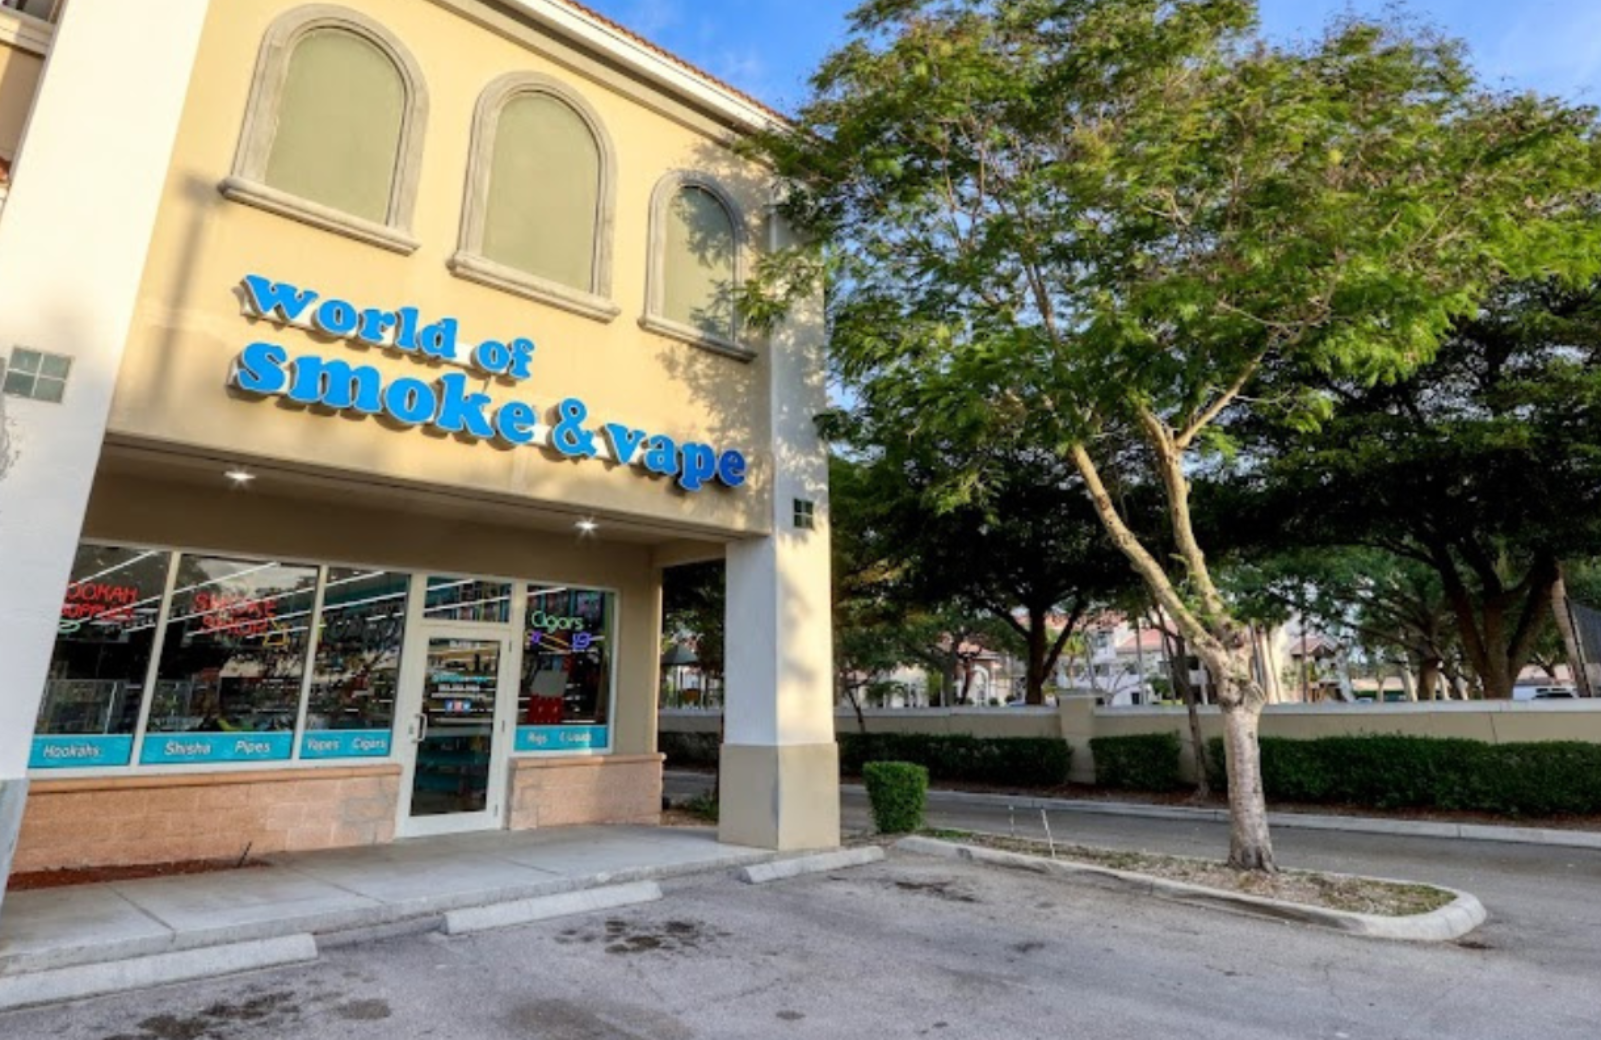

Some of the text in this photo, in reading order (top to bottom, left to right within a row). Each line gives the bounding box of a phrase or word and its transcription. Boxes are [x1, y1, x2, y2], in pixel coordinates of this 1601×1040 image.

[245, 274, 535, 380] world of
[238, 342, 747, 492] smoke & vape
[67, 582, 138, 603] OOKAH
[531, 610, 584, 634] Cigars
[43, 744, 101, 758] Hookahs
[164, 739, 271, 756] Shisha Pipes
[307, 736, 387, 751] Vapes Cigars
